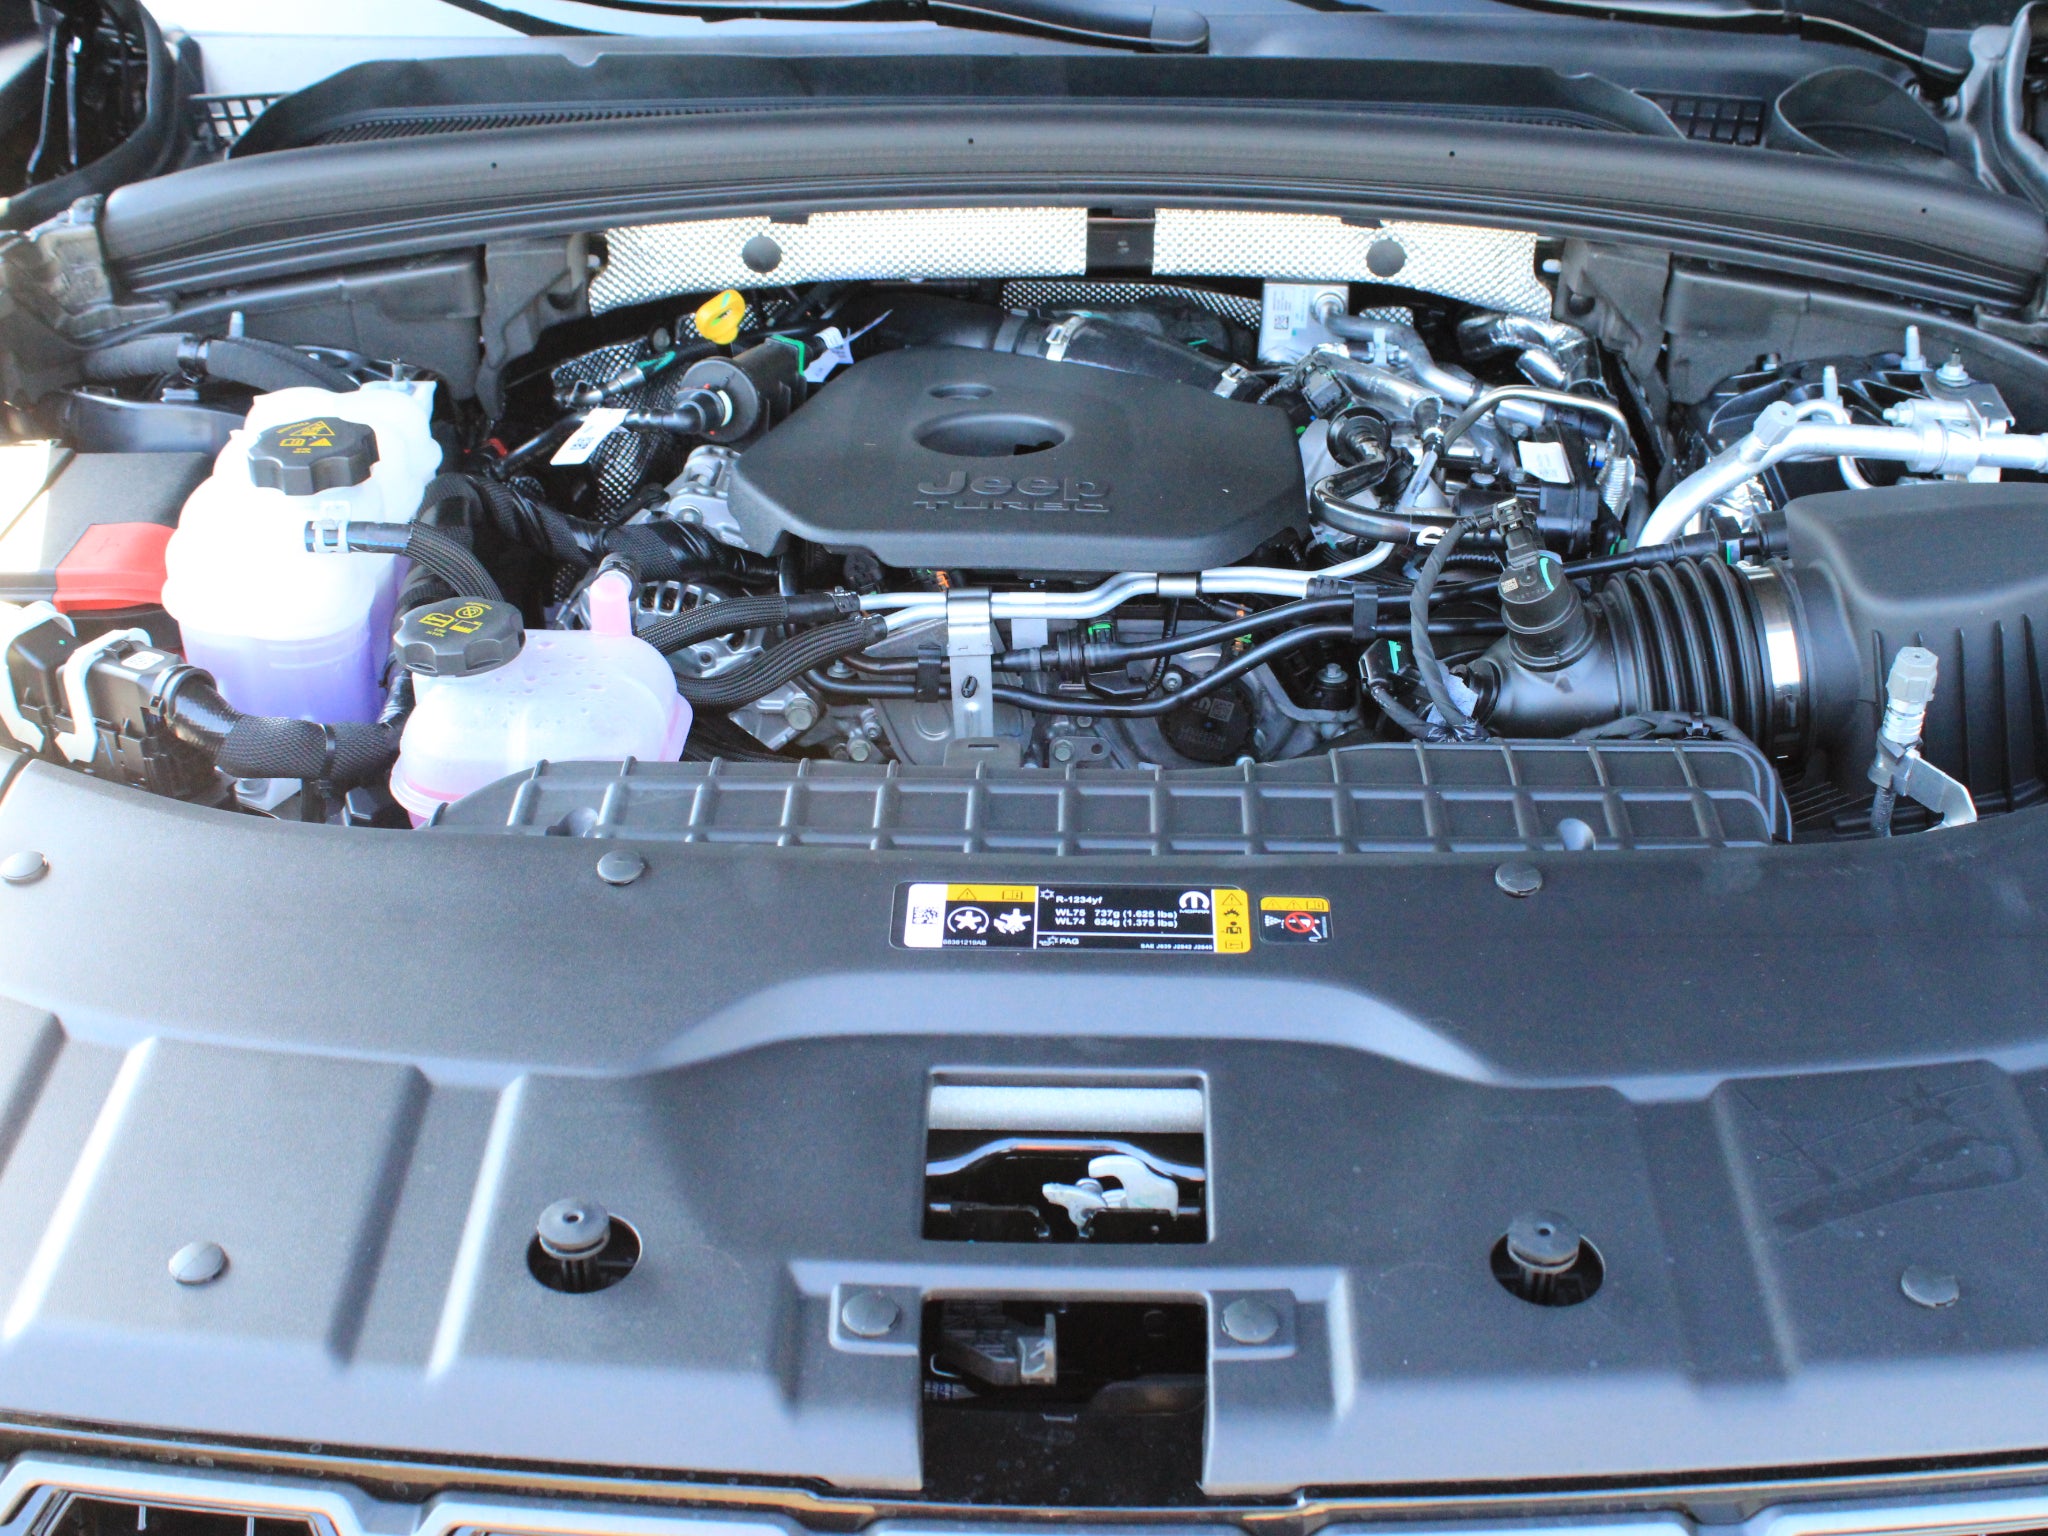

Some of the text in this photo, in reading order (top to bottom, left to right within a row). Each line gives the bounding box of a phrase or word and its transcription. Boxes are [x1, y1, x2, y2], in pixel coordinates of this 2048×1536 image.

[917, 471, 1109, 502] Jeep
[1055, 895, 1103, 905] R-1234yf
[1055, 908, 1178, 919] WL75 737g (1.625 lbs)
[1055, 917, 1178, 928] WL74 624g (1.375 lbs)
[1059, 937, 1080, 945] PAG
